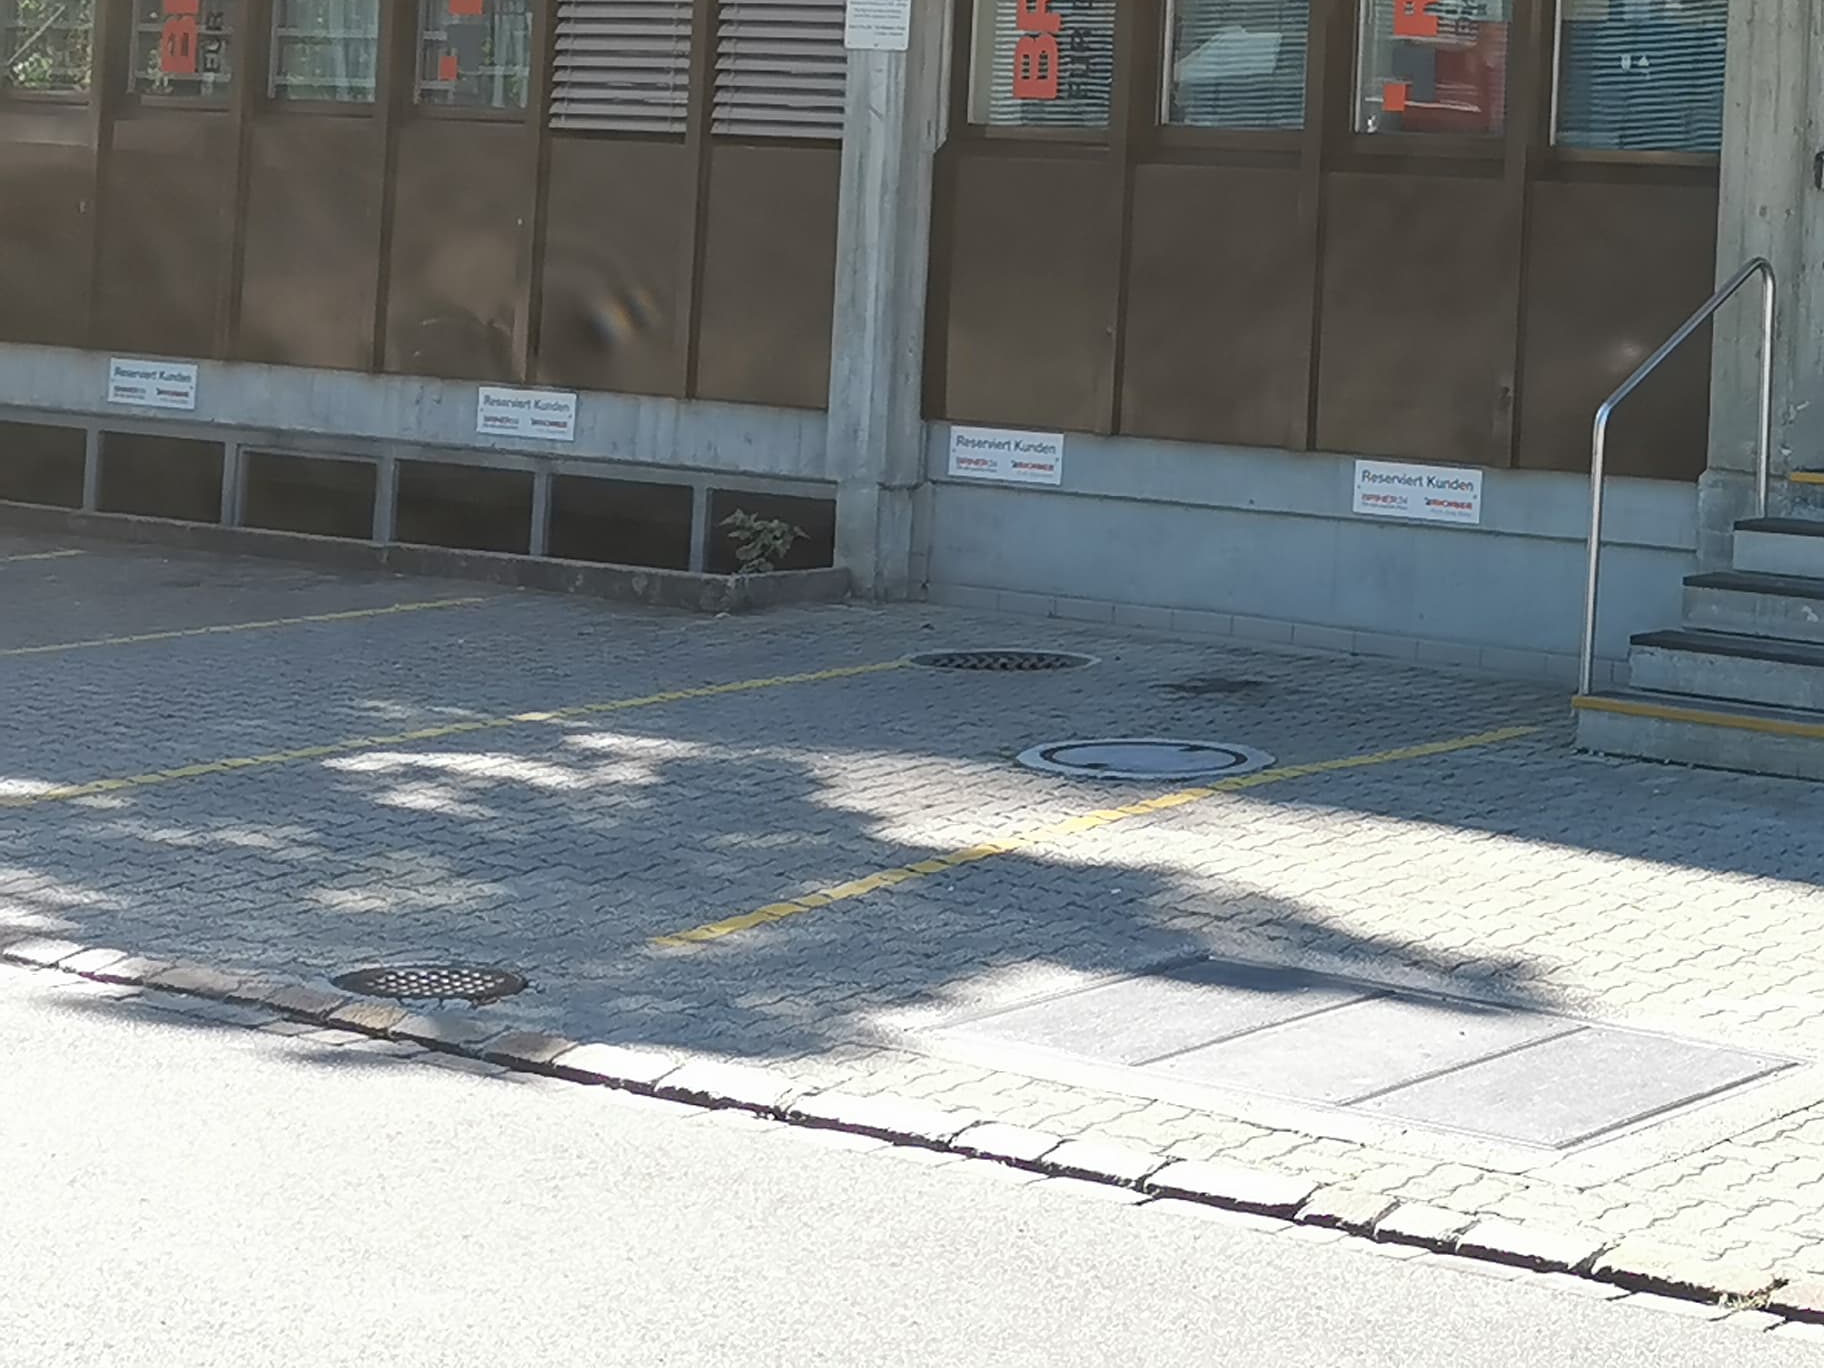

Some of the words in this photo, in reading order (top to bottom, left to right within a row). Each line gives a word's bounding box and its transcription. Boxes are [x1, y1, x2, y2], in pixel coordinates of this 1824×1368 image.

[956, 435, 1011, 451] Reserviert
[1014, 440, 1056, 454] Kunden
[1362, 469, 1423, 487] Reserviert
[1427, 476, 1474, 491] Kunden
